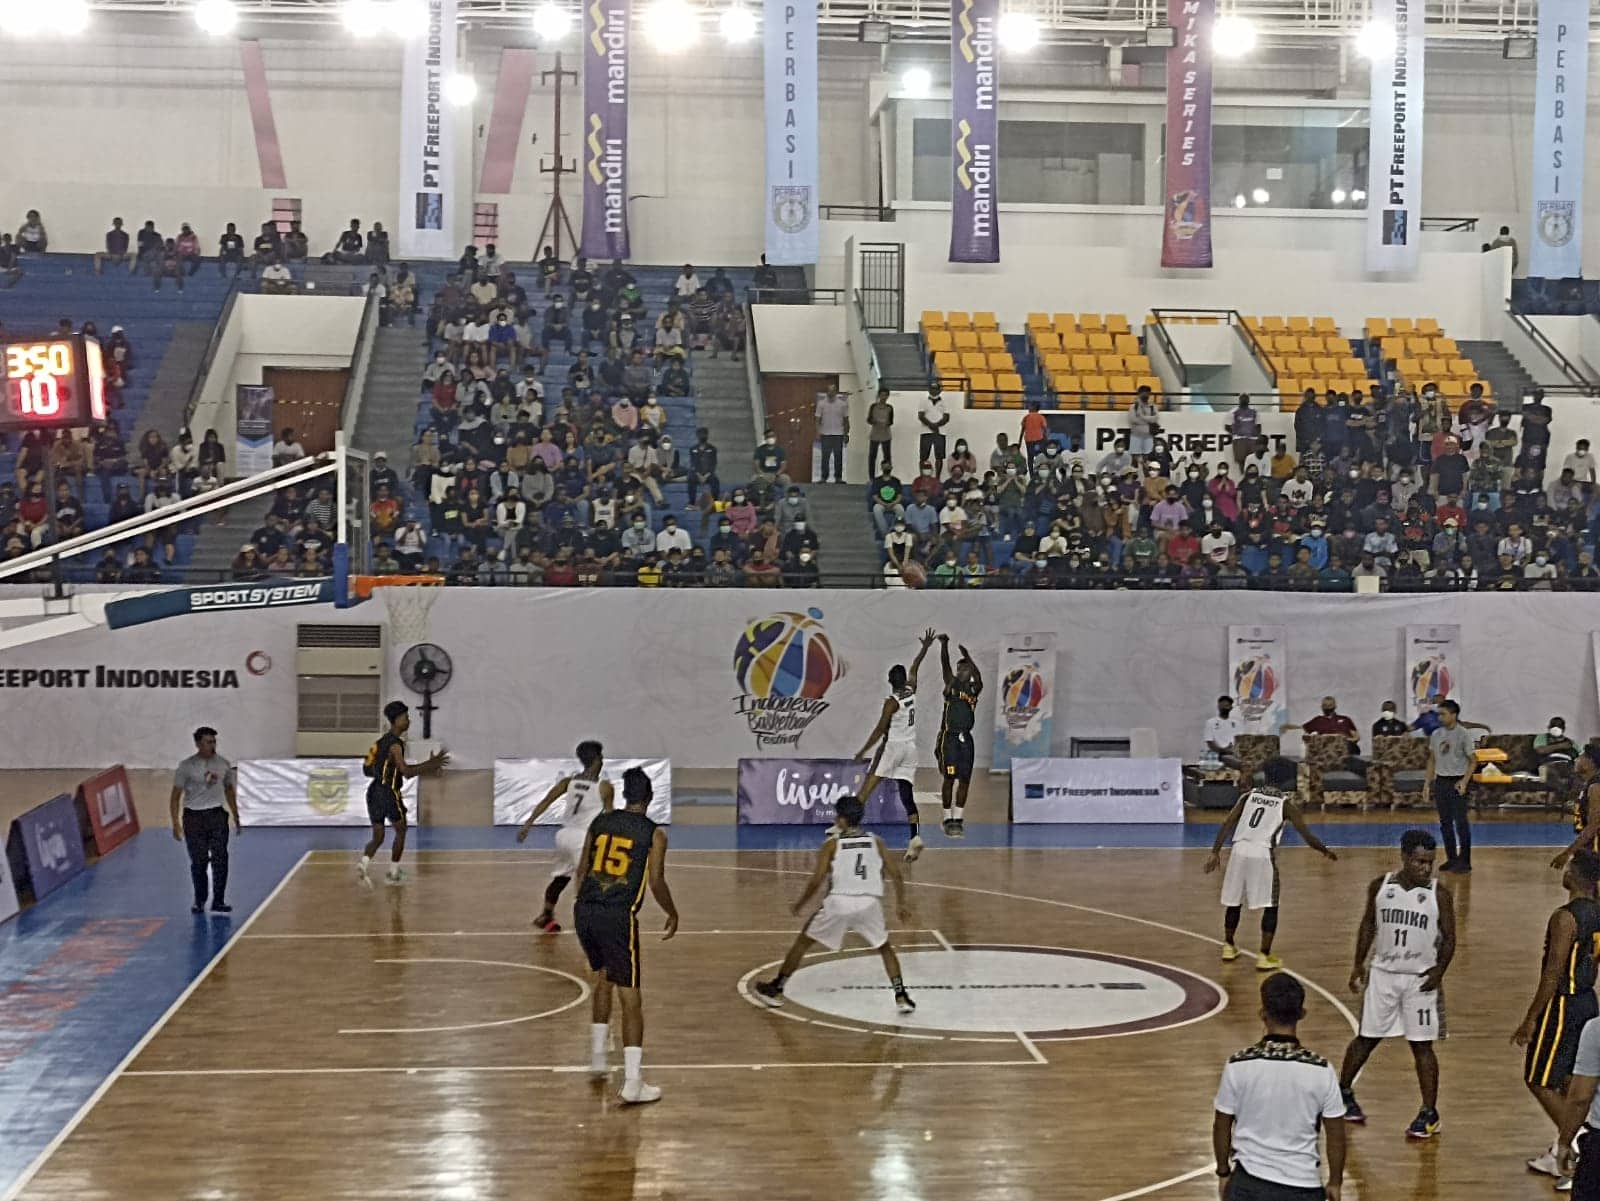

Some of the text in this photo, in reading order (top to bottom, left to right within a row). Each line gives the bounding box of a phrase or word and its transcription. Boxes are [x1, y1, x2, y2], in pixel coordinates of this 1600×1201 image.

[603, 9, 625, 104] mandiri
[971, 17, 993, 110] mandiri
[785, 6, 796, 179] PERBASI
[424, 69, 441, 156] FREEPORT
[1182, 71, 1197, 166] SERIES
[1553, 24, 1567, 194] PERBASI
[1390, 91, 1407, 176] FREEPORT
[423, 161, 439, 188] PT
[600, 138, 622, 233] mandiri
[969, 144, 991, 237] mandiri
[1390, 178, 1405, 204] PT
[20, 375, 60, 415] 10
[96, 665, 239, 688] INDONESIA
[732, 694, 830, 716] Indonesia
[747, 711, 817, 734] Basketball
[573, 793, 584, 815] 7
[1046, 787, 1159, 796] PT FREEPORT INDONESIA
[1249, 807, 1265, 829] 0
[592, 834, 634, 877] 15
[855, 853, 867, 880] 4
[1380, 908, 1429, 931] TIMIKA
[1394, 928, 1408, 947] 11
[1417, 1008, 1431, 1026] 11
